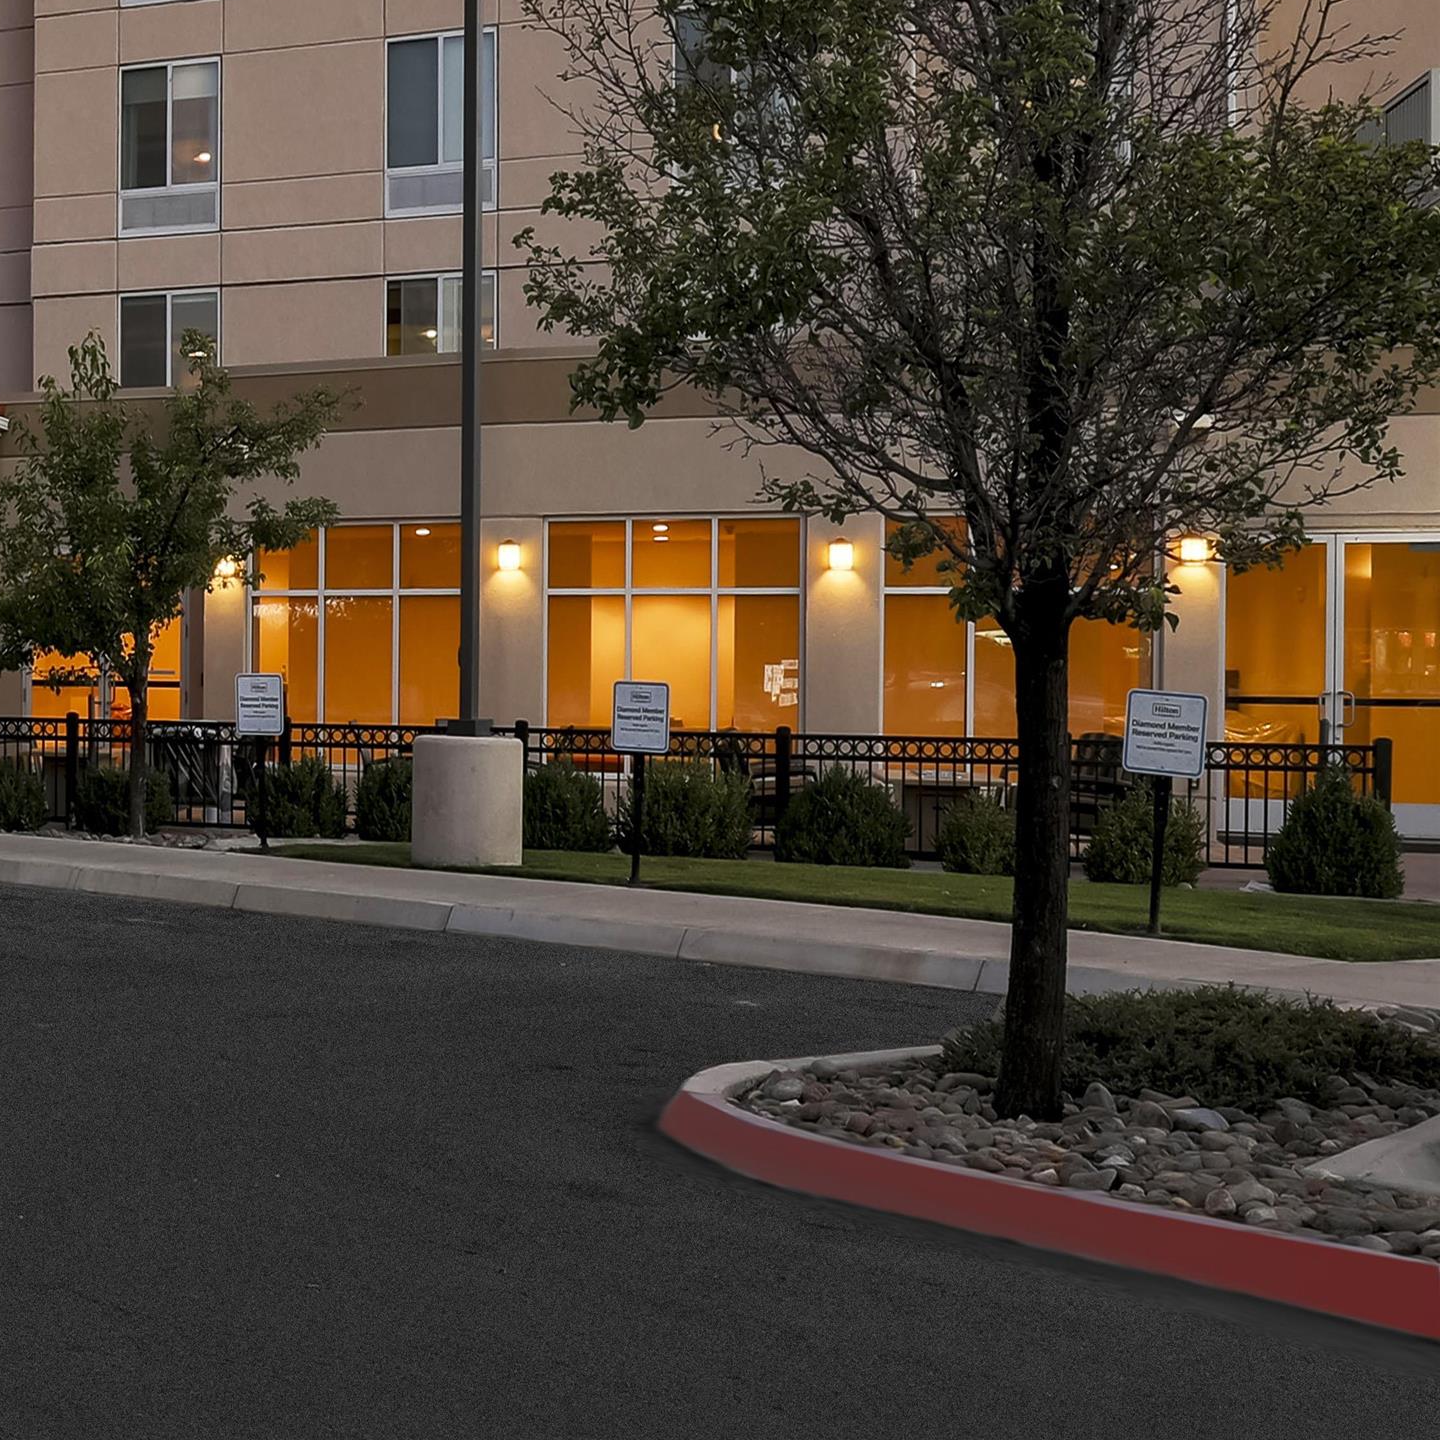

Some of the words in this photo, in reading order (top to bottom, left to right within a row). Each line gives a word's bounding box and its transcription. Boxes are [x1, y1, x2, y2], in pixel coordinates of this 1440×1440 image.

[1154, 705, 1179, 714] Hilton
[1132, 719, 1166, 729] Diamond
[1167, 722, 1200, 732] Member
[1132, 728, 1168, 739] Reserved
[1169, 731, 1199, 743] Parking
